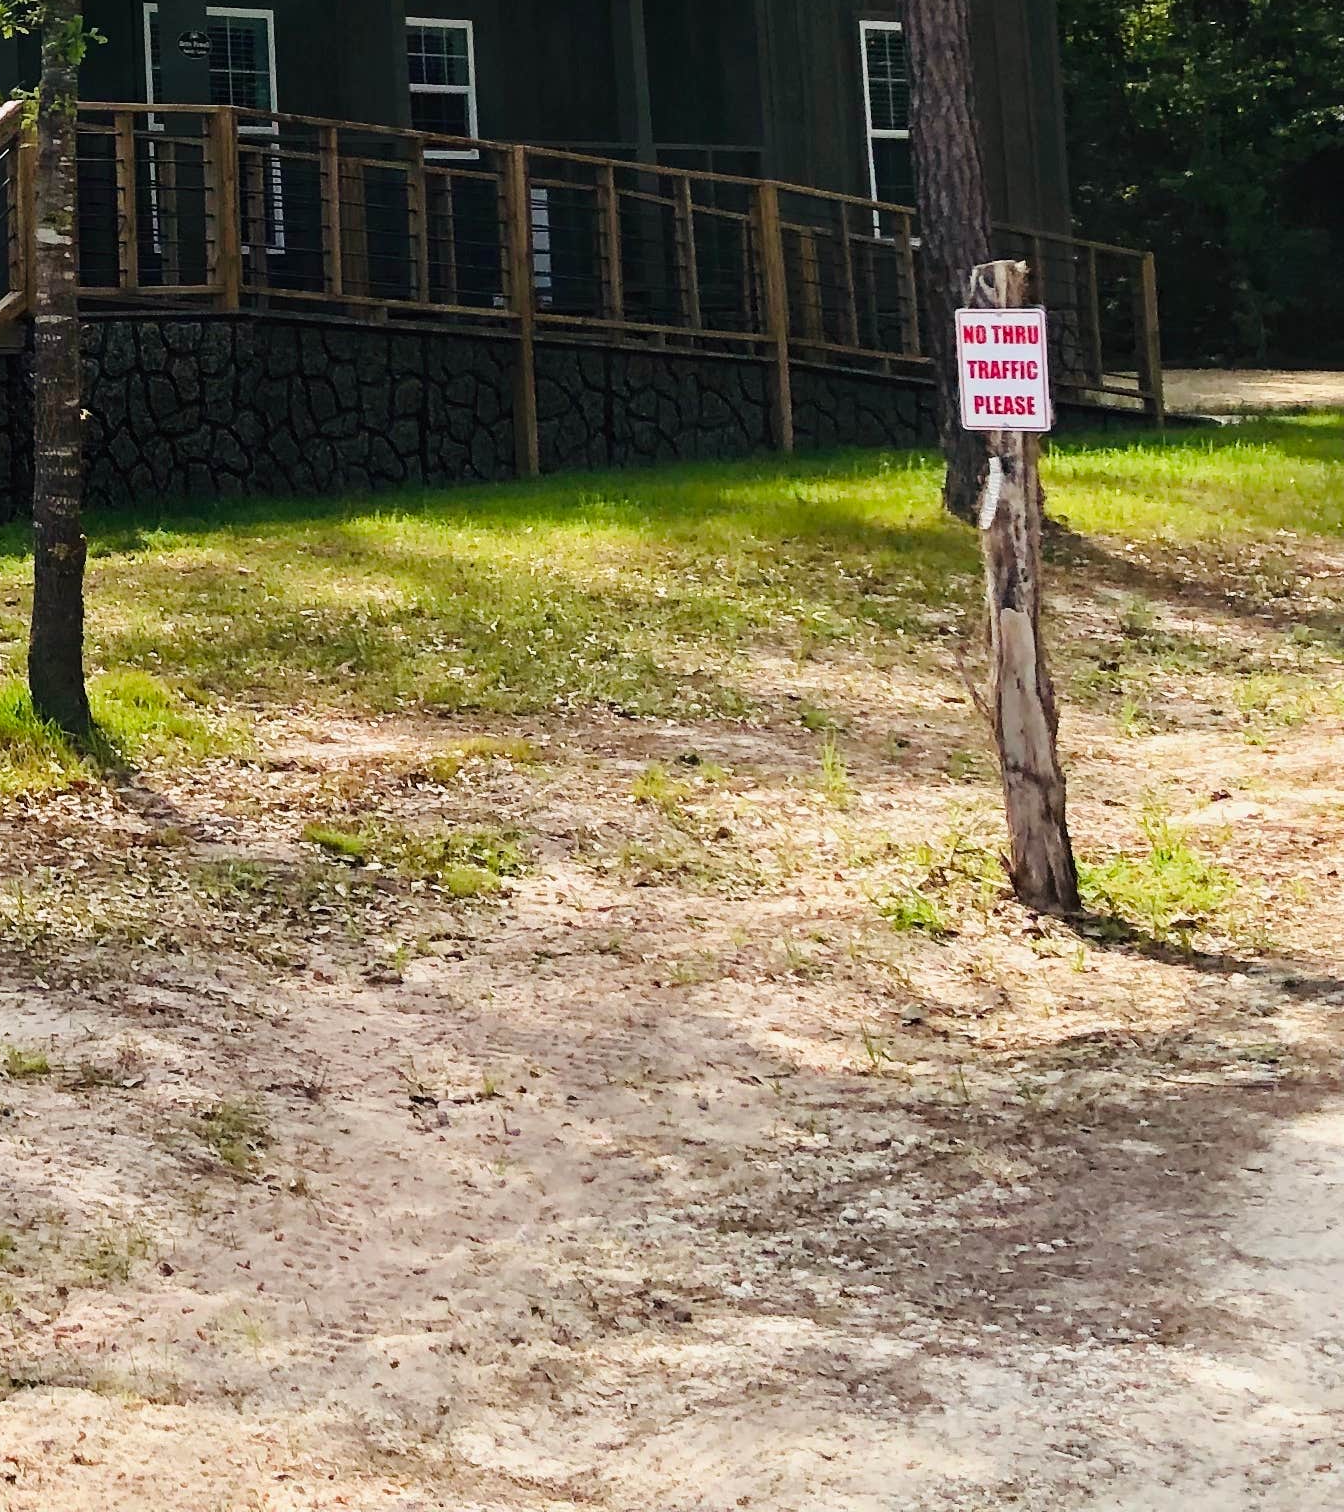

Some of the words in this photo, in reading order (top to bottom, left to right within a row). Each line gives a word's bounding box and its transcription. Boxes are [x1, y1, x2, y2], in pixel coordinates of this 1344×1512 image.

[963, 324, 987, 345] NO
[990, 324, 1039, 345] THRU
[967, 360, 1038, 380] TRAFFIC
[973, 395, 1036, 416] PLEASE
